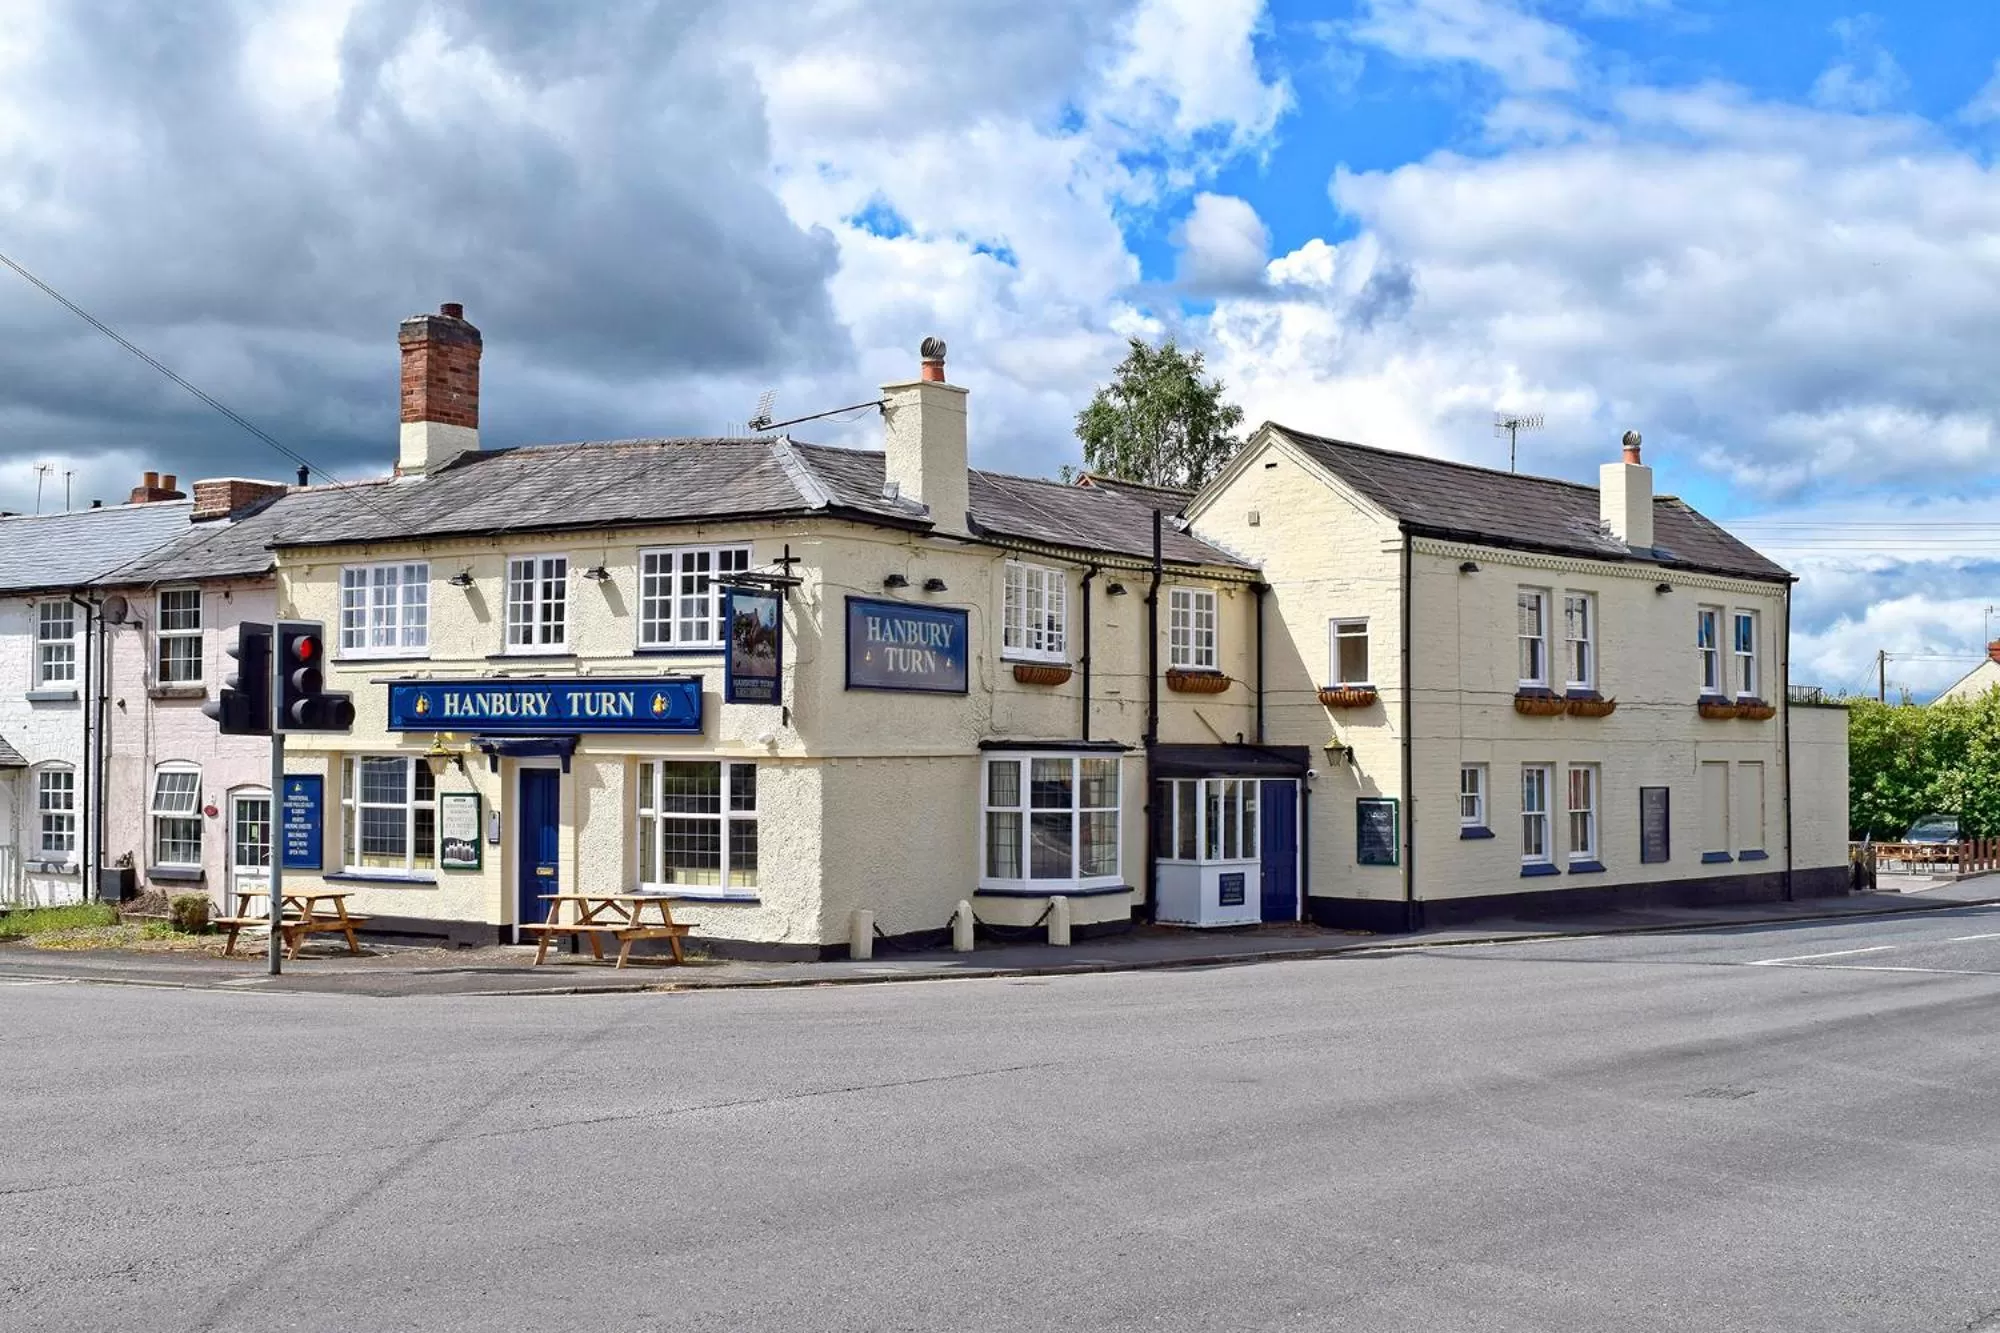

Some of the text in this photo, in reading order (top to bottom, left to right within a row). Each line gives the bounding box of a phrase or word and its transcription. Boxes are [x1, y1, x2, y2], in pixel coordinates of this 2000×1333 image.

[865, 616, 953, 648] HANBURY
[884, 647, 936, 673] TURN
[443, 692, 635, 717] HANBURY TURN
